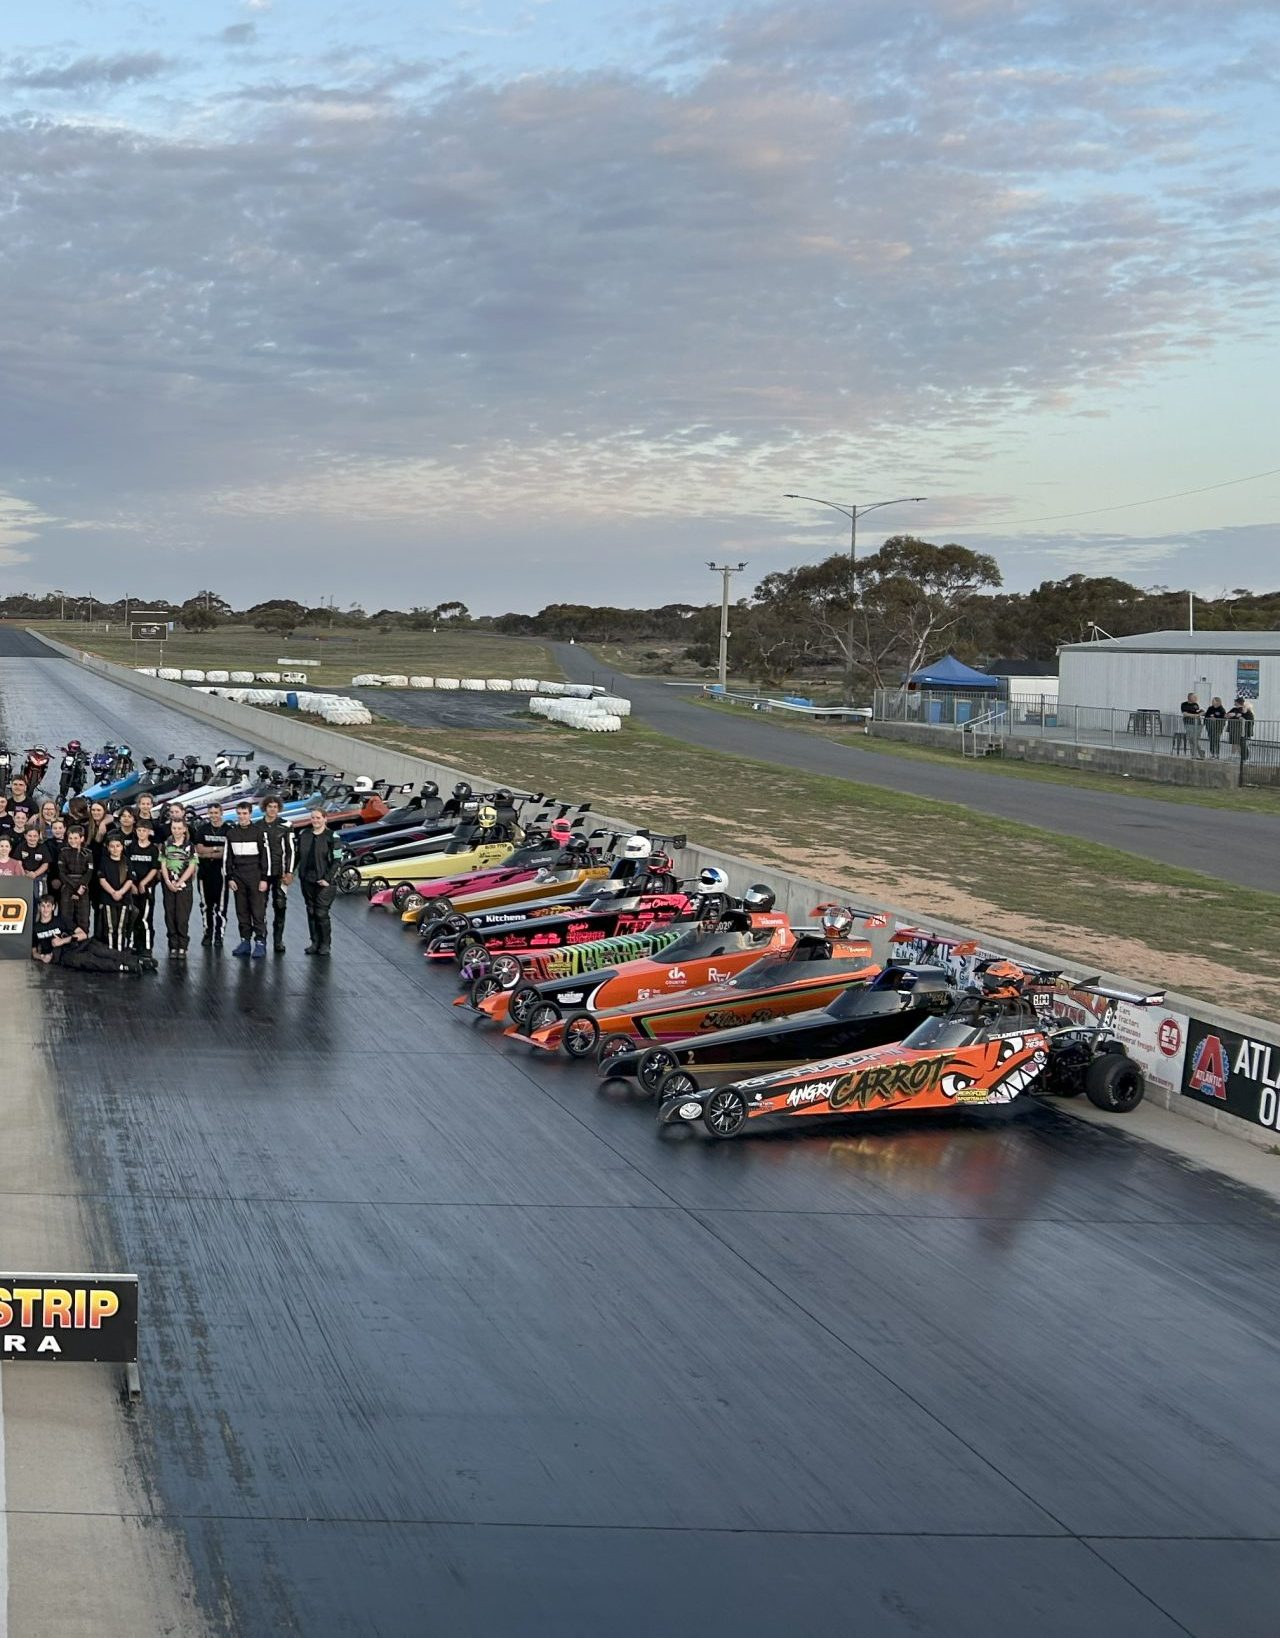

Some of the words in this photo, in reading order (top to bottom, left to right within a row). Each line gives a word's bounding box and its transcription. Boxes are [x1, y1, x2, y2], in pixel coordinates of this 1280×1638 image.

[485, 914, 527, 923] Kitchens
[686, 1051, 696, 1065] 2
[1233, 1038, 1280, 1090] ATL
[786, 1079, 838, 1108] ANGRY
[829, 1053, 958, 1109] CARROT
[1195, 1069, 1223, 1088] ATLANTIC
